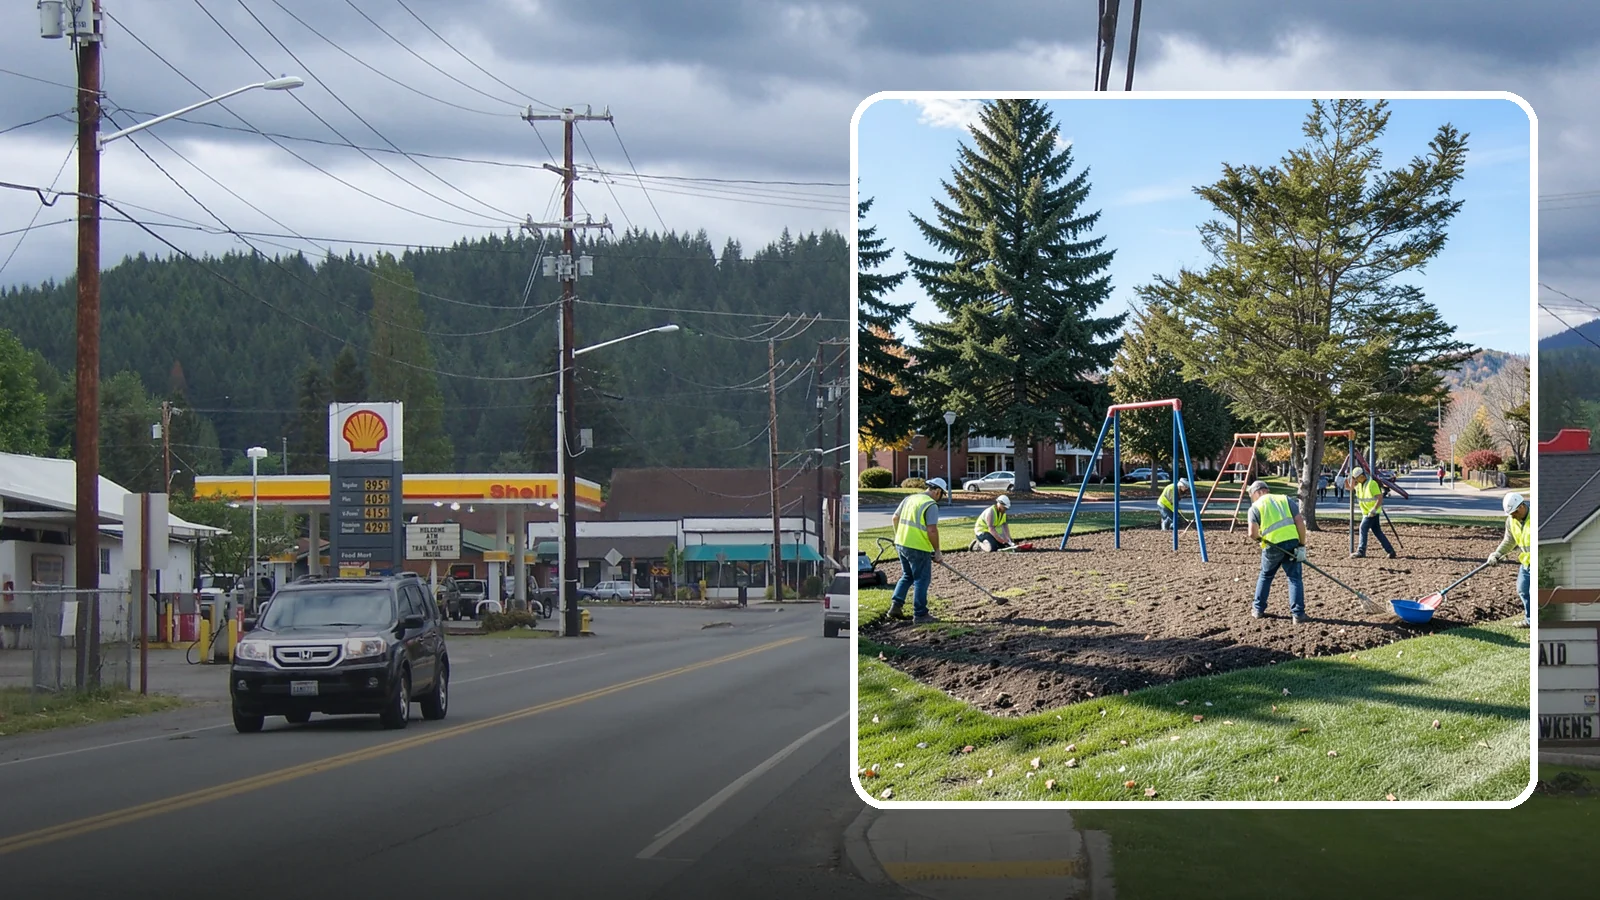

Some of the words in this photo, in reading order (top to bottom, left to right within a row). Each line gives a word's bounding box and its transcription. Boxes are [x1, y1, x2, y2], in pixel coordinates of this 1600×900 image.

[365, 480, 383, 490] 395
[490, 484, 548, 499] Shell
[365, 494, 383, 504] 405
[365, 508, 383, 518] 415
[365, 522, 383, 533] 429
